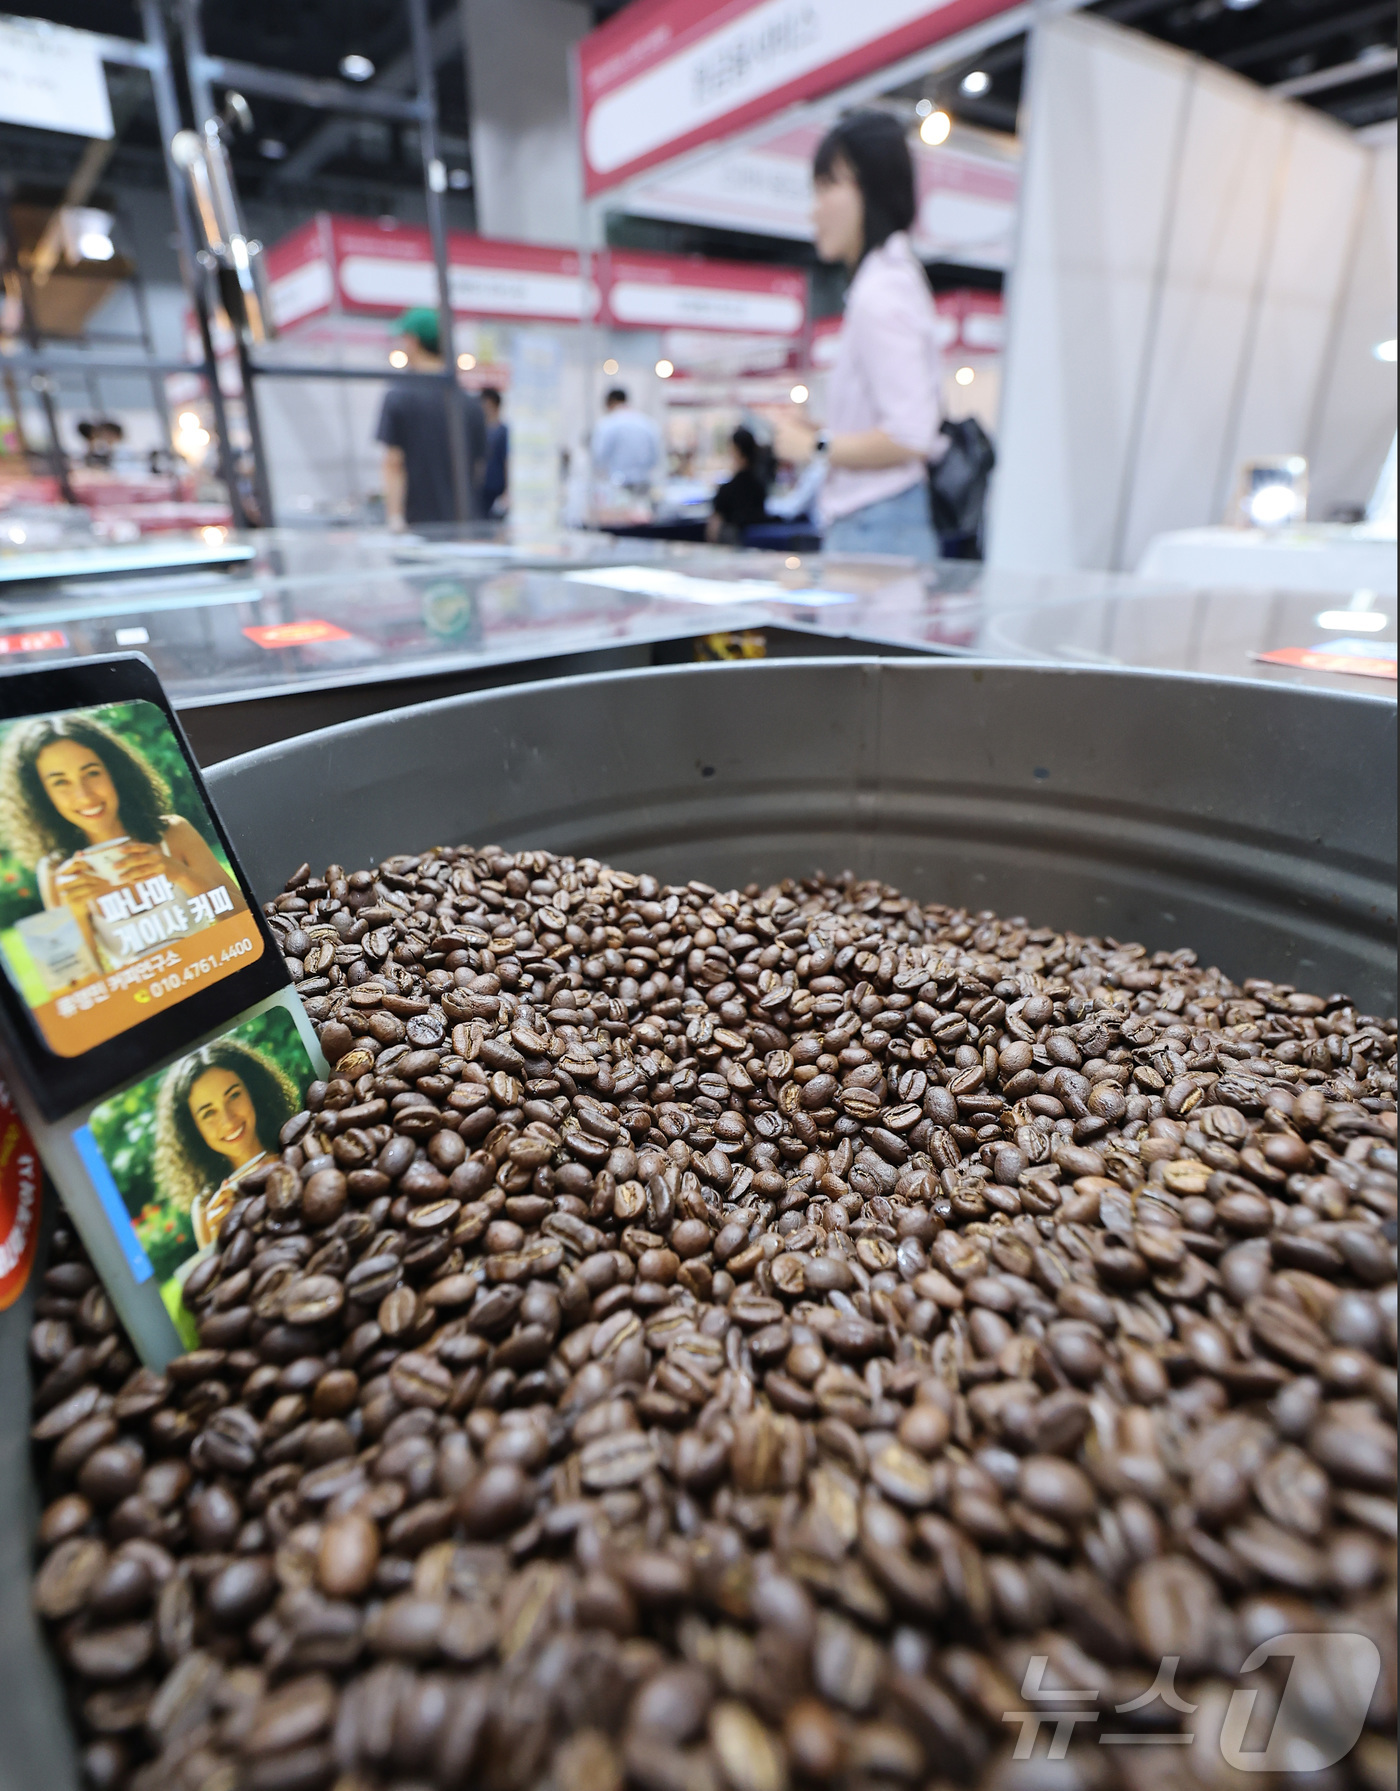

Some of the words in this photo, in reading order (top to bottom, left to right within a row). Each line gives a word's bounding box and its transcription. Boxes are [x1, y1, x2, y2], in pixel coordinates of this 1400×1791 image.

[97, 873, 175, 923] 파나마
[113, 903, 190, 956] 게이샤
[187, 885, 235, 924] 커피
[150, 937, 253, 998] 010.4761.4400
